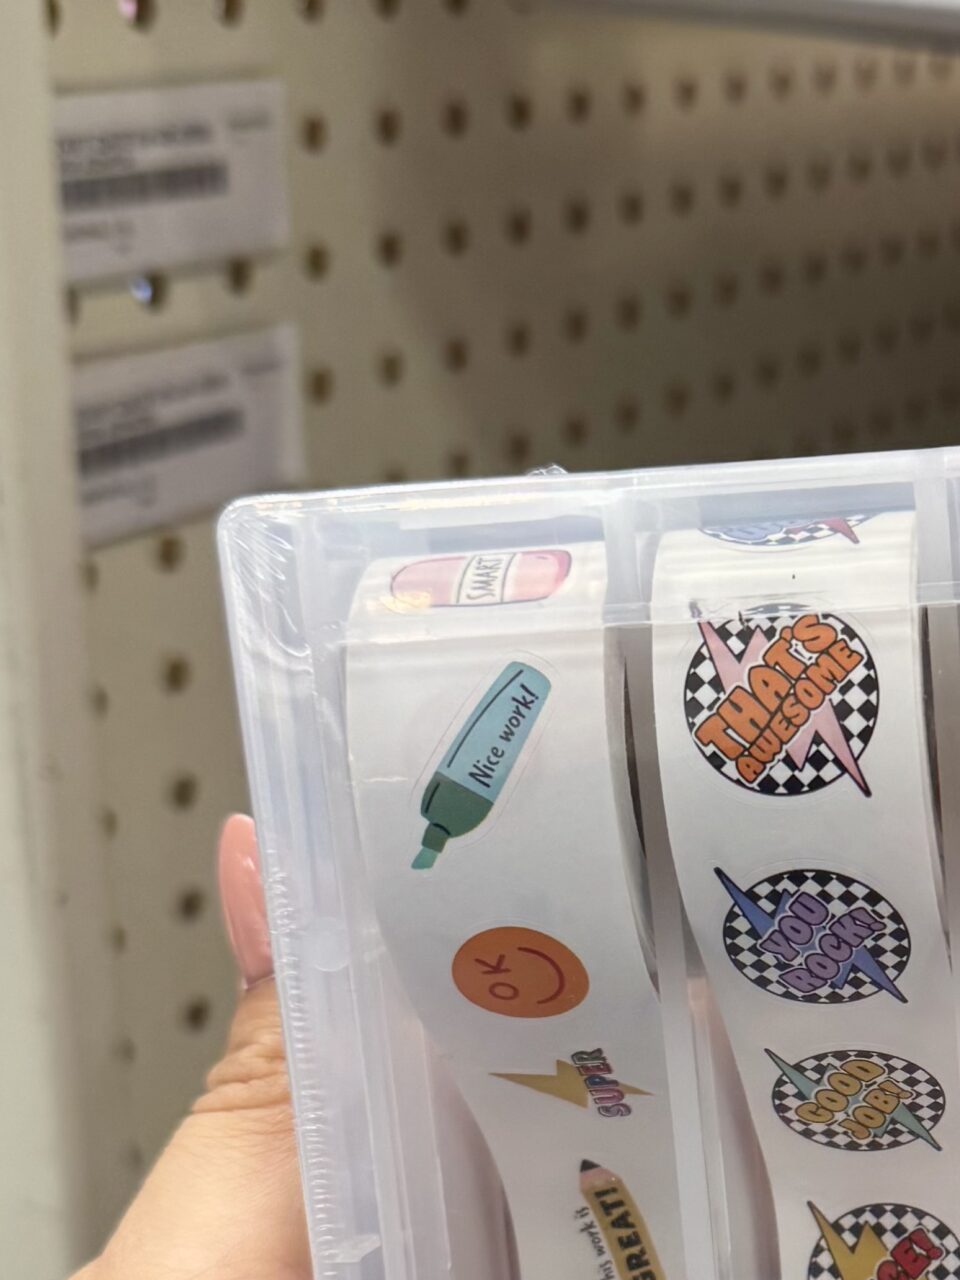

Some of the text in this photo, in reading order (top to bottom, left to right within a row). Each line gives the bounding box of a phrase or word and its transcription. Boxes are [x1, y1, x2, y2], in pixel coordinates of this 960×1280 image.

[466, 556, 503, 600] SMART
[695, 613, 838, 761] THAT'S
[736, 637, 864, 783] AWESOME
[468, 683, 539, 788] Nice work!
[758, 891, 829, 961] YOU
[779, 906, 887, 993] ROCK!
[570, 1047, 632, 1118] SUPER
[794, 1058, 886, 1123] GOOD
[837, 1079, 914, 1140] JOB!
[580, 1221, 606, 1257] work
